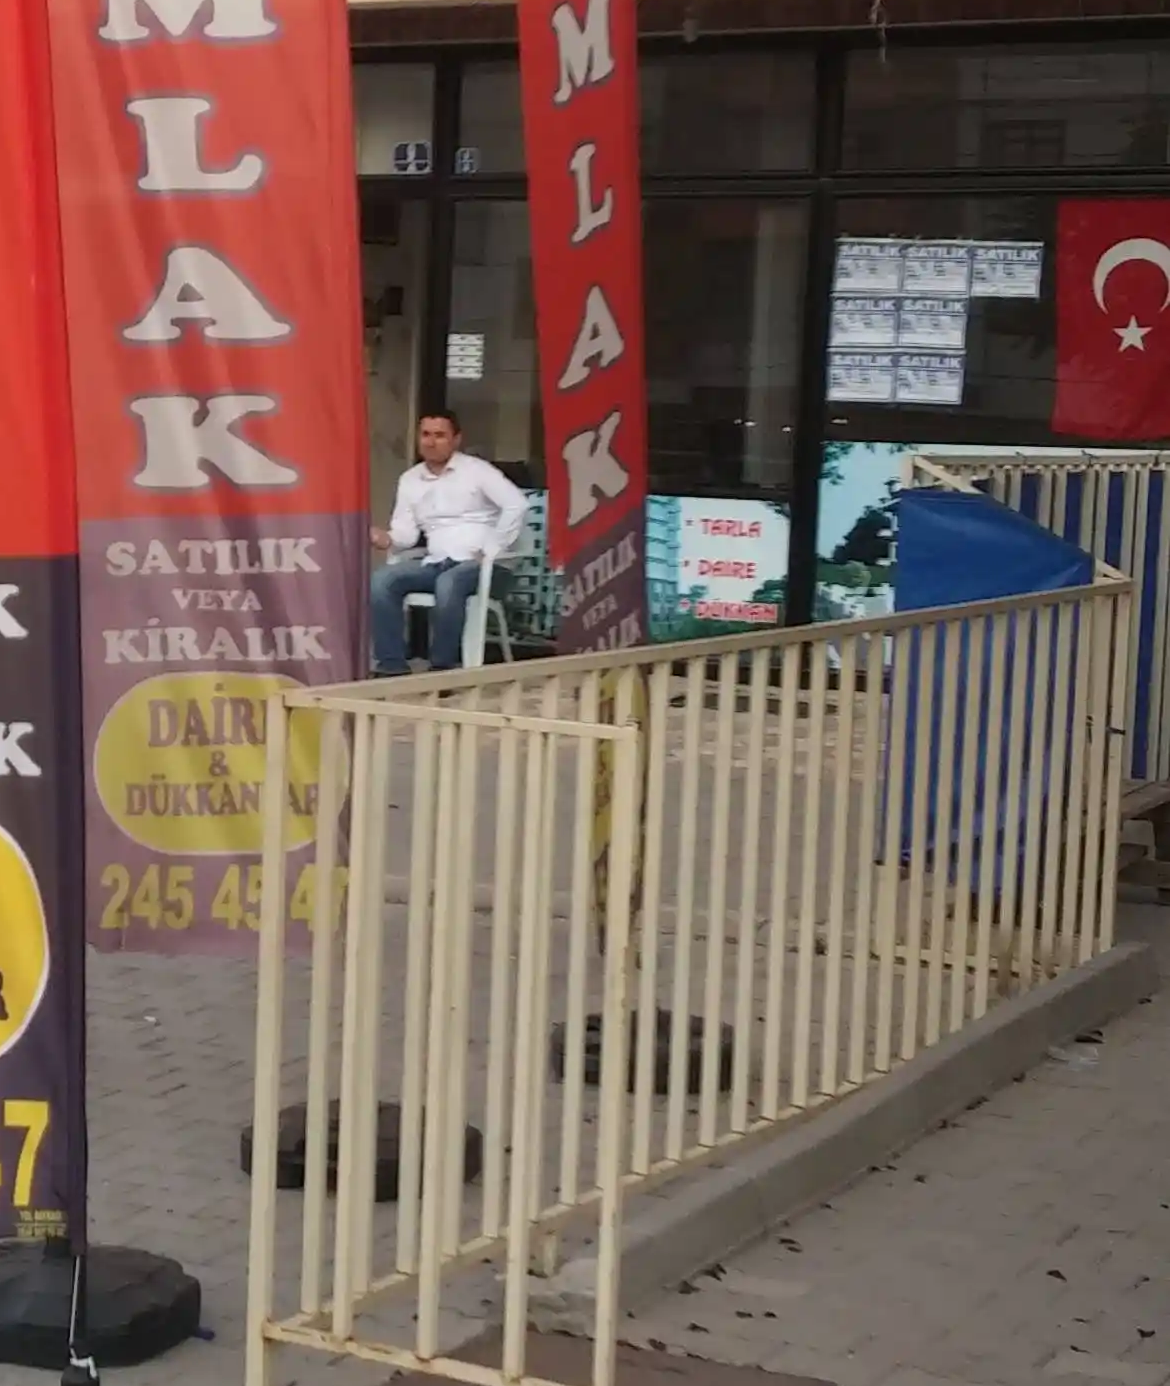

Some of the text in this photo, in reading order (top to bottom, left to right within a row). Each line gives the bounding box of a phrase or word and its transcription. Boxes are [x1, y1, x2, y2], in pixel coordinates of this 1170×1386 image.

[974, 247, 1042, 261] SATILIK
[105, 536, 321, 576] SATILIK
[172, 587, 263, 613] VEYA
[102, 617, 332, 665] KİRALIK
[147, 682, 268, 747] DAİR
[208, 751, 229, 777] &
[99, 863, 194, 931] 245
